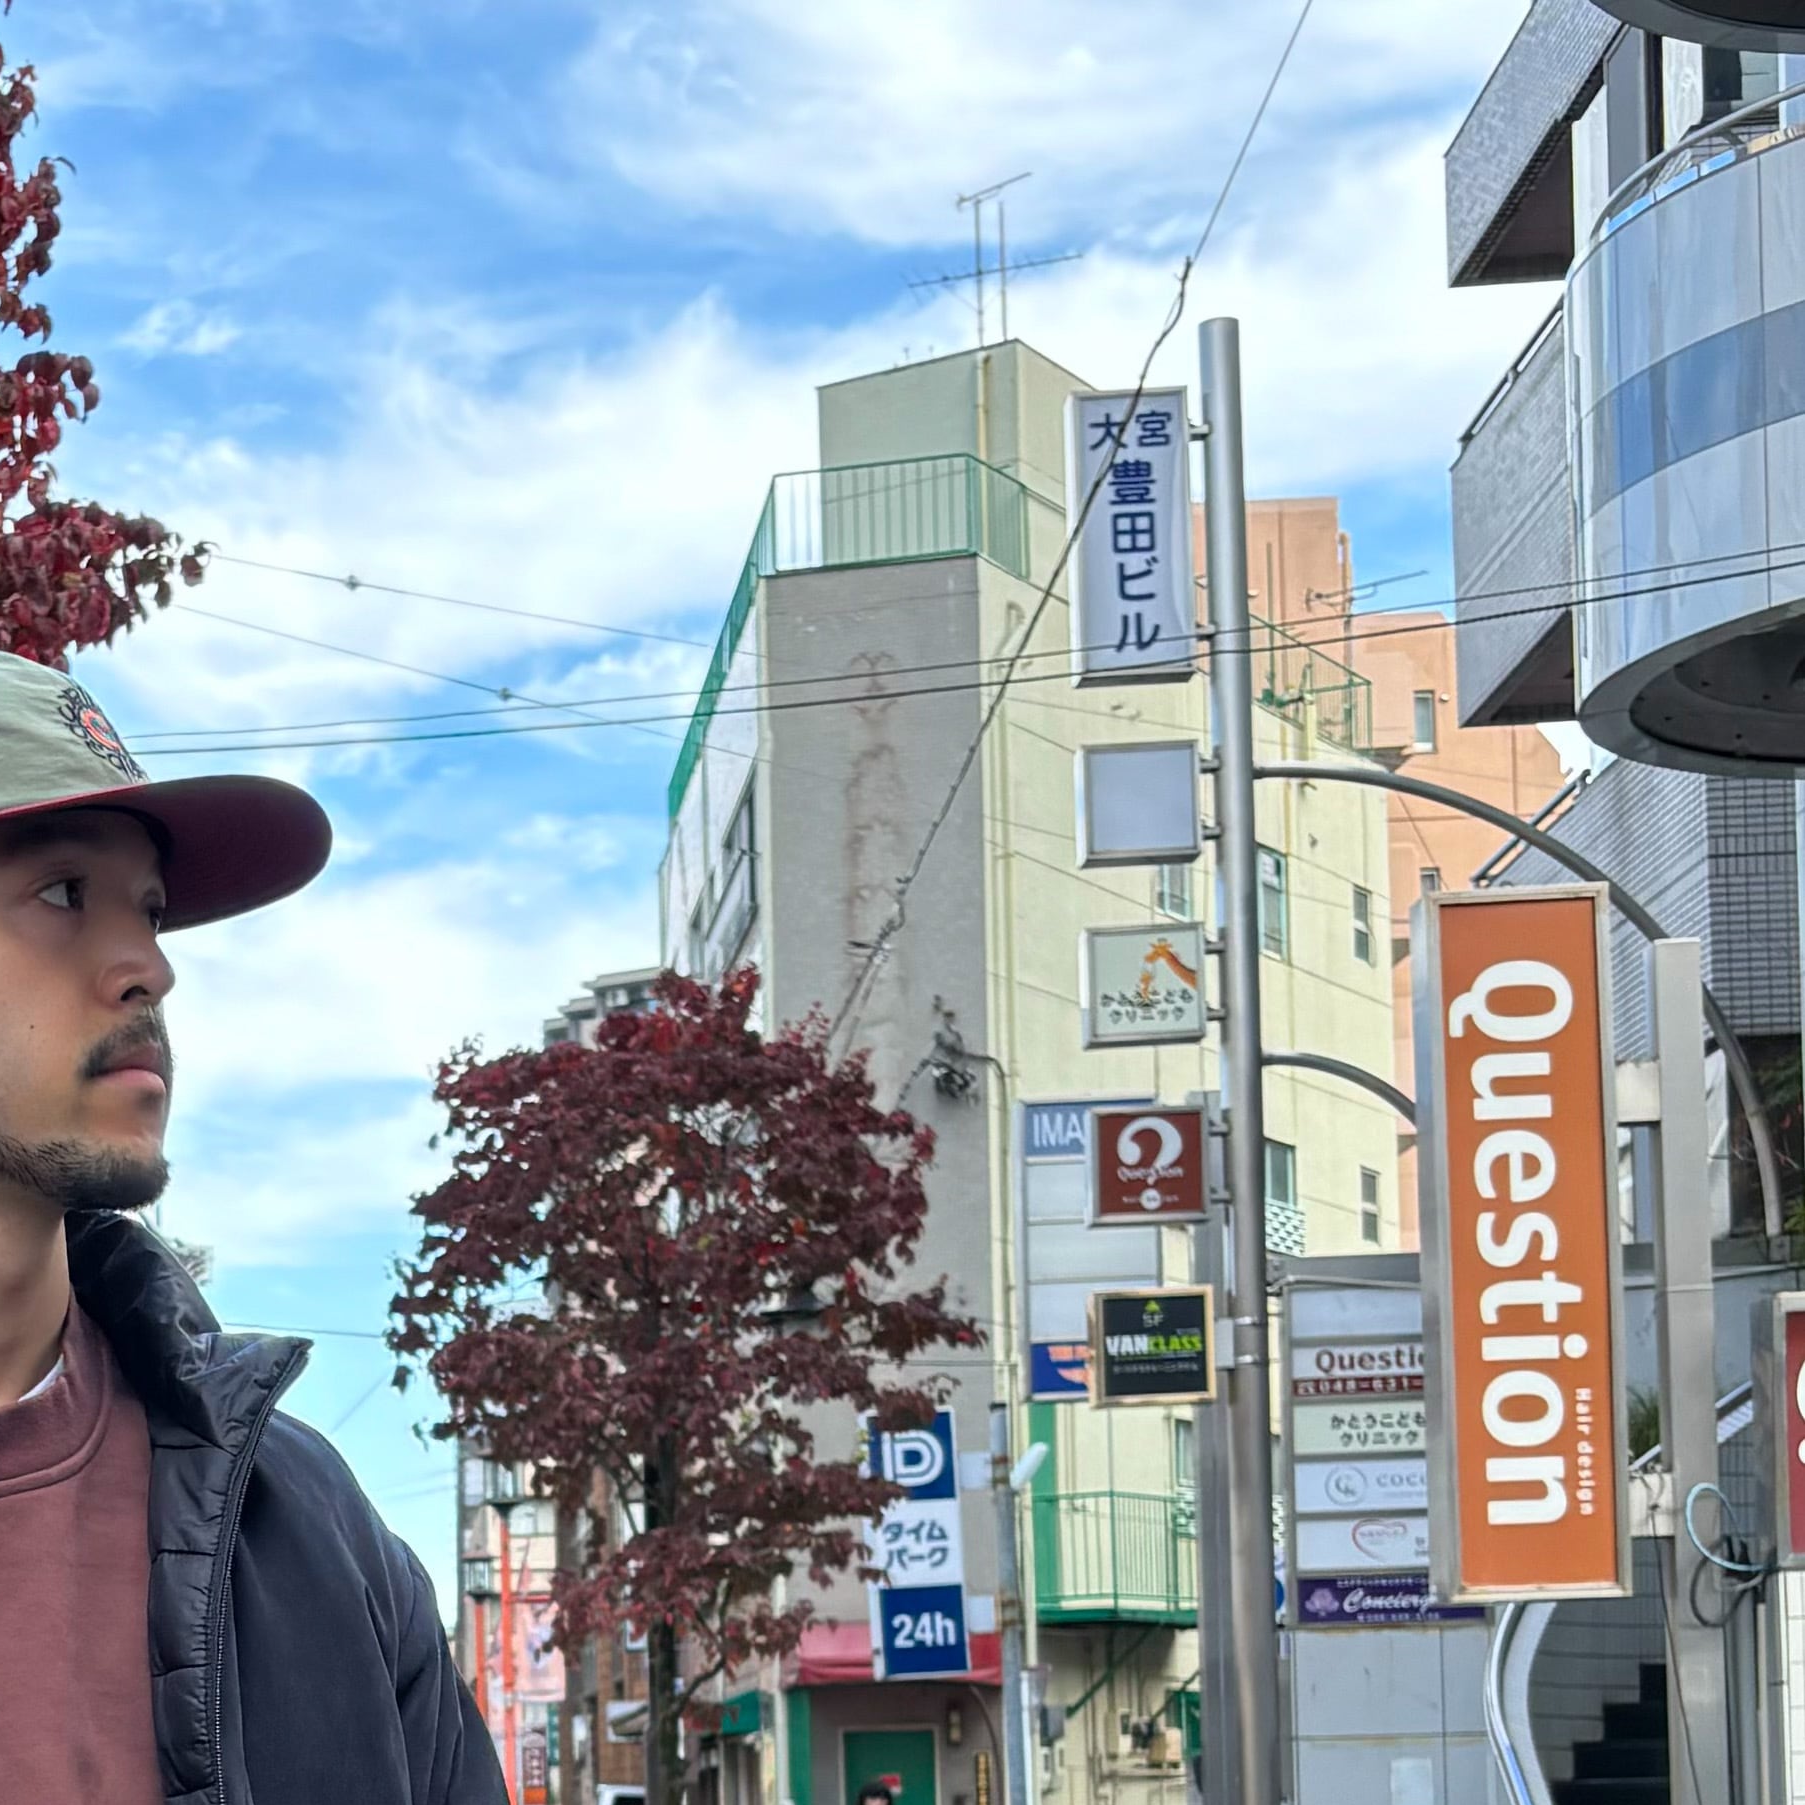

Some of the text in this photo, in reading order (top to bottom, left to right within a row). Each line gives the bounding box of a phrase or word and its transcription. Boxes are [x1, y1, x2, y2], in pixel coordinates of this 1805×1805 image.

[1088, 410, 1173, 451] 大宮
[1107, 458, 1161, 653] 豊田ビル
[1448, 960, 1588, 1525] Question
[1331, 1411, 1427, 1430] かとうこども
[1575, 1387, 1596, 1516] Hair design
[883, 1520, 948, 1544] タイム
[892, 1611, 956, 1648] 24h
